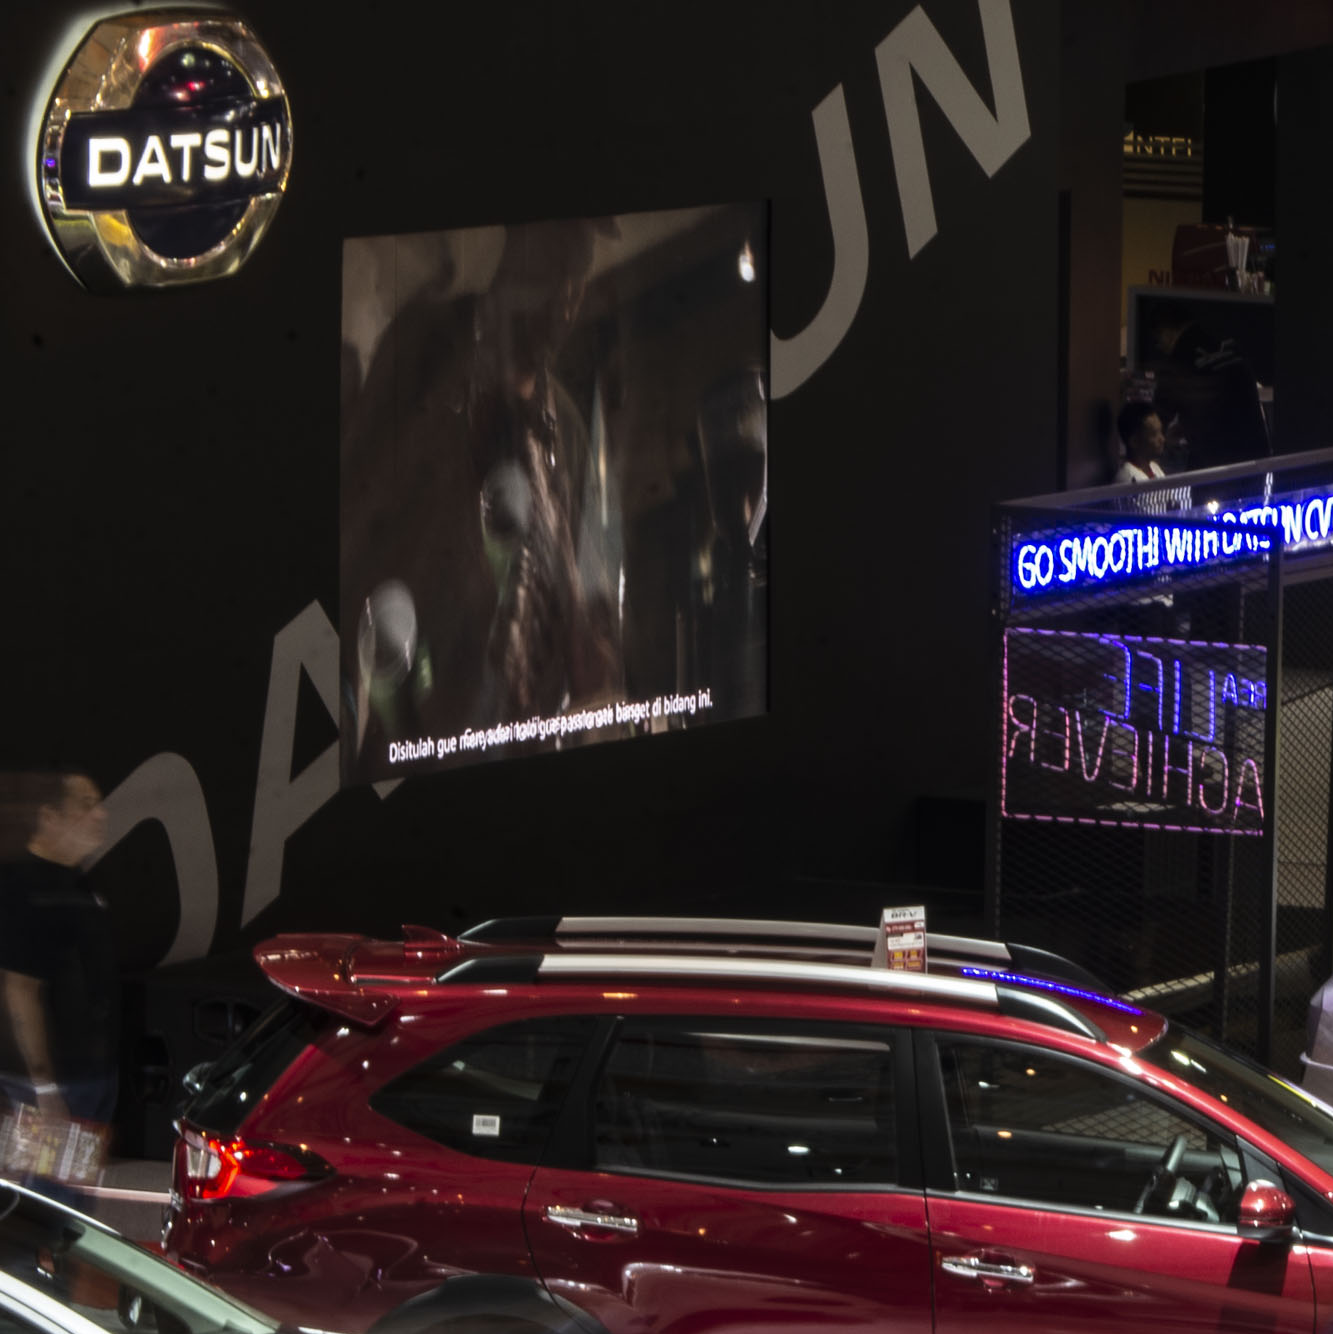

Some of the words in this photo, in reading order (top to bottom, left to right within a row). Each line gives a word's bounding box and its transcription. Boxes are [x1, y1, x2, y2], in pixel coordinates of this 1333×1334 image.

[88, 122, 281, 187] DATSUN
[1018, 544, 1054, 589] GO
[388, 736, 434, 764] Disitulah
[437, 735, 457, 759] gue
[652, 696, 662, 717] di
[664, 692, 696, 716] bidang
